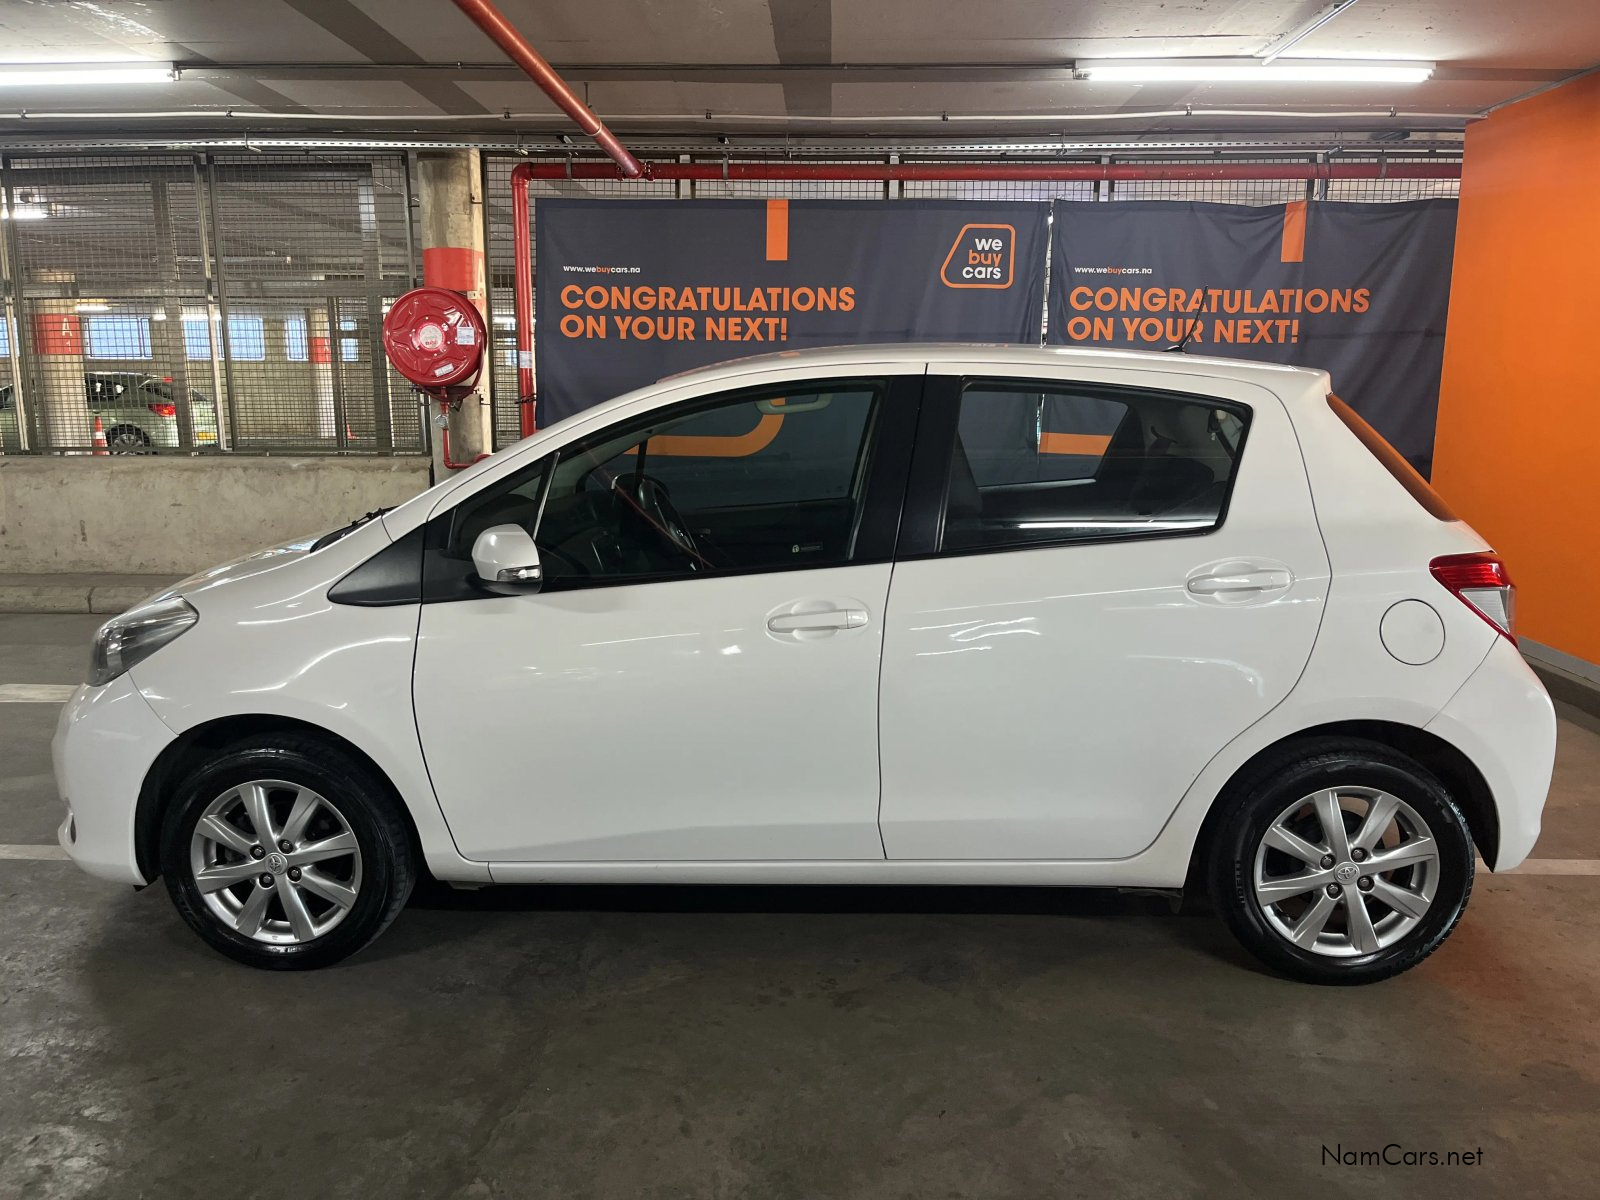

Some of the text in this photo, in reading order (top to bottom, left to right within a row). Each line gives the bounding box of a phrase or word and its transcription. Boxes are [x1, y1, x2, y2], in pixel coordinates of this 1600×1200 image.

[975, 238, 1003, 251] we
[968, 249, 1002, 267] buy
[562, 265, 641, 274] www.webuycars.na
[962, 266, 1002, 279] cars
[1074, 266, 1153, 276] www.webuycars.na
[560, 284, 856, 312] CONGRATULATIONS
[1069, 285, 1370, 314] CONGRATULATIONS
[62, 317, 73, 337] A
[560, 314, 789, 342] ON YOUR NEXT!
[1067, 316, 1300, 344] ON YOUR NEXT!
